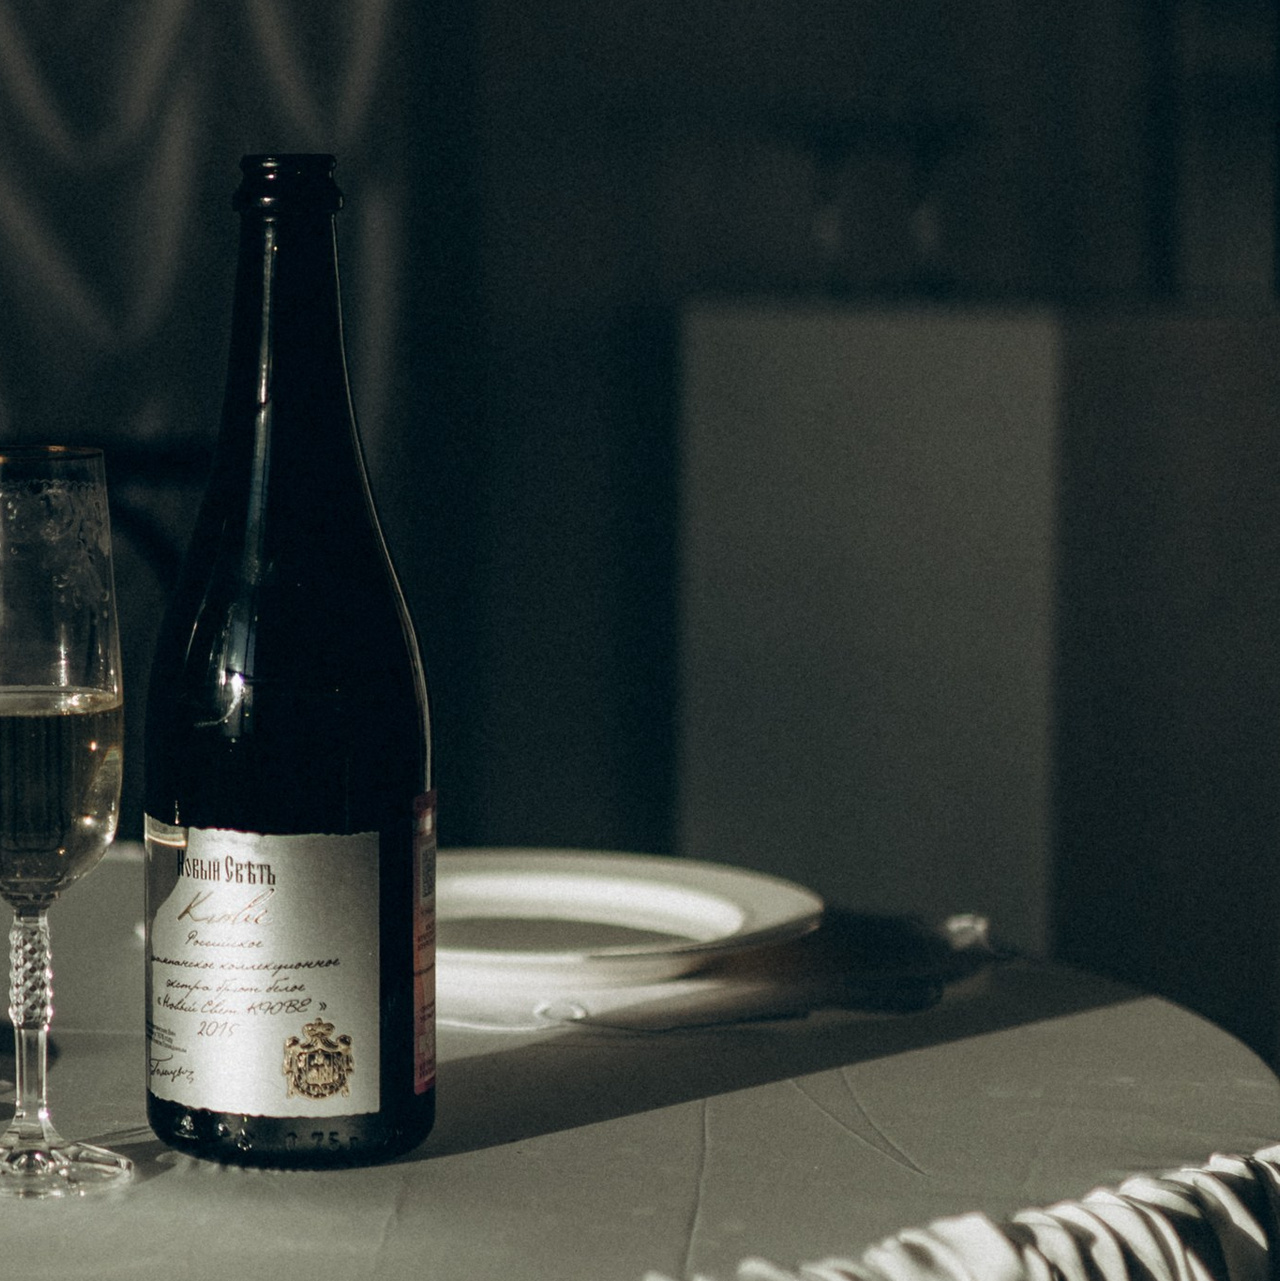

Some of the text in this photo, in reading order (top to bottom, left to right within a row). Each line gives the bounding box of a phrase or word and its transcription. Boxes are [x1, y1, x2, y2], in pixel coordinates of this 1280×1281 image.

[219, 958, 340, 977] коллекционное
[266, 977, 306, 993] белое
[197, 1020, 240, 1038] 2015
